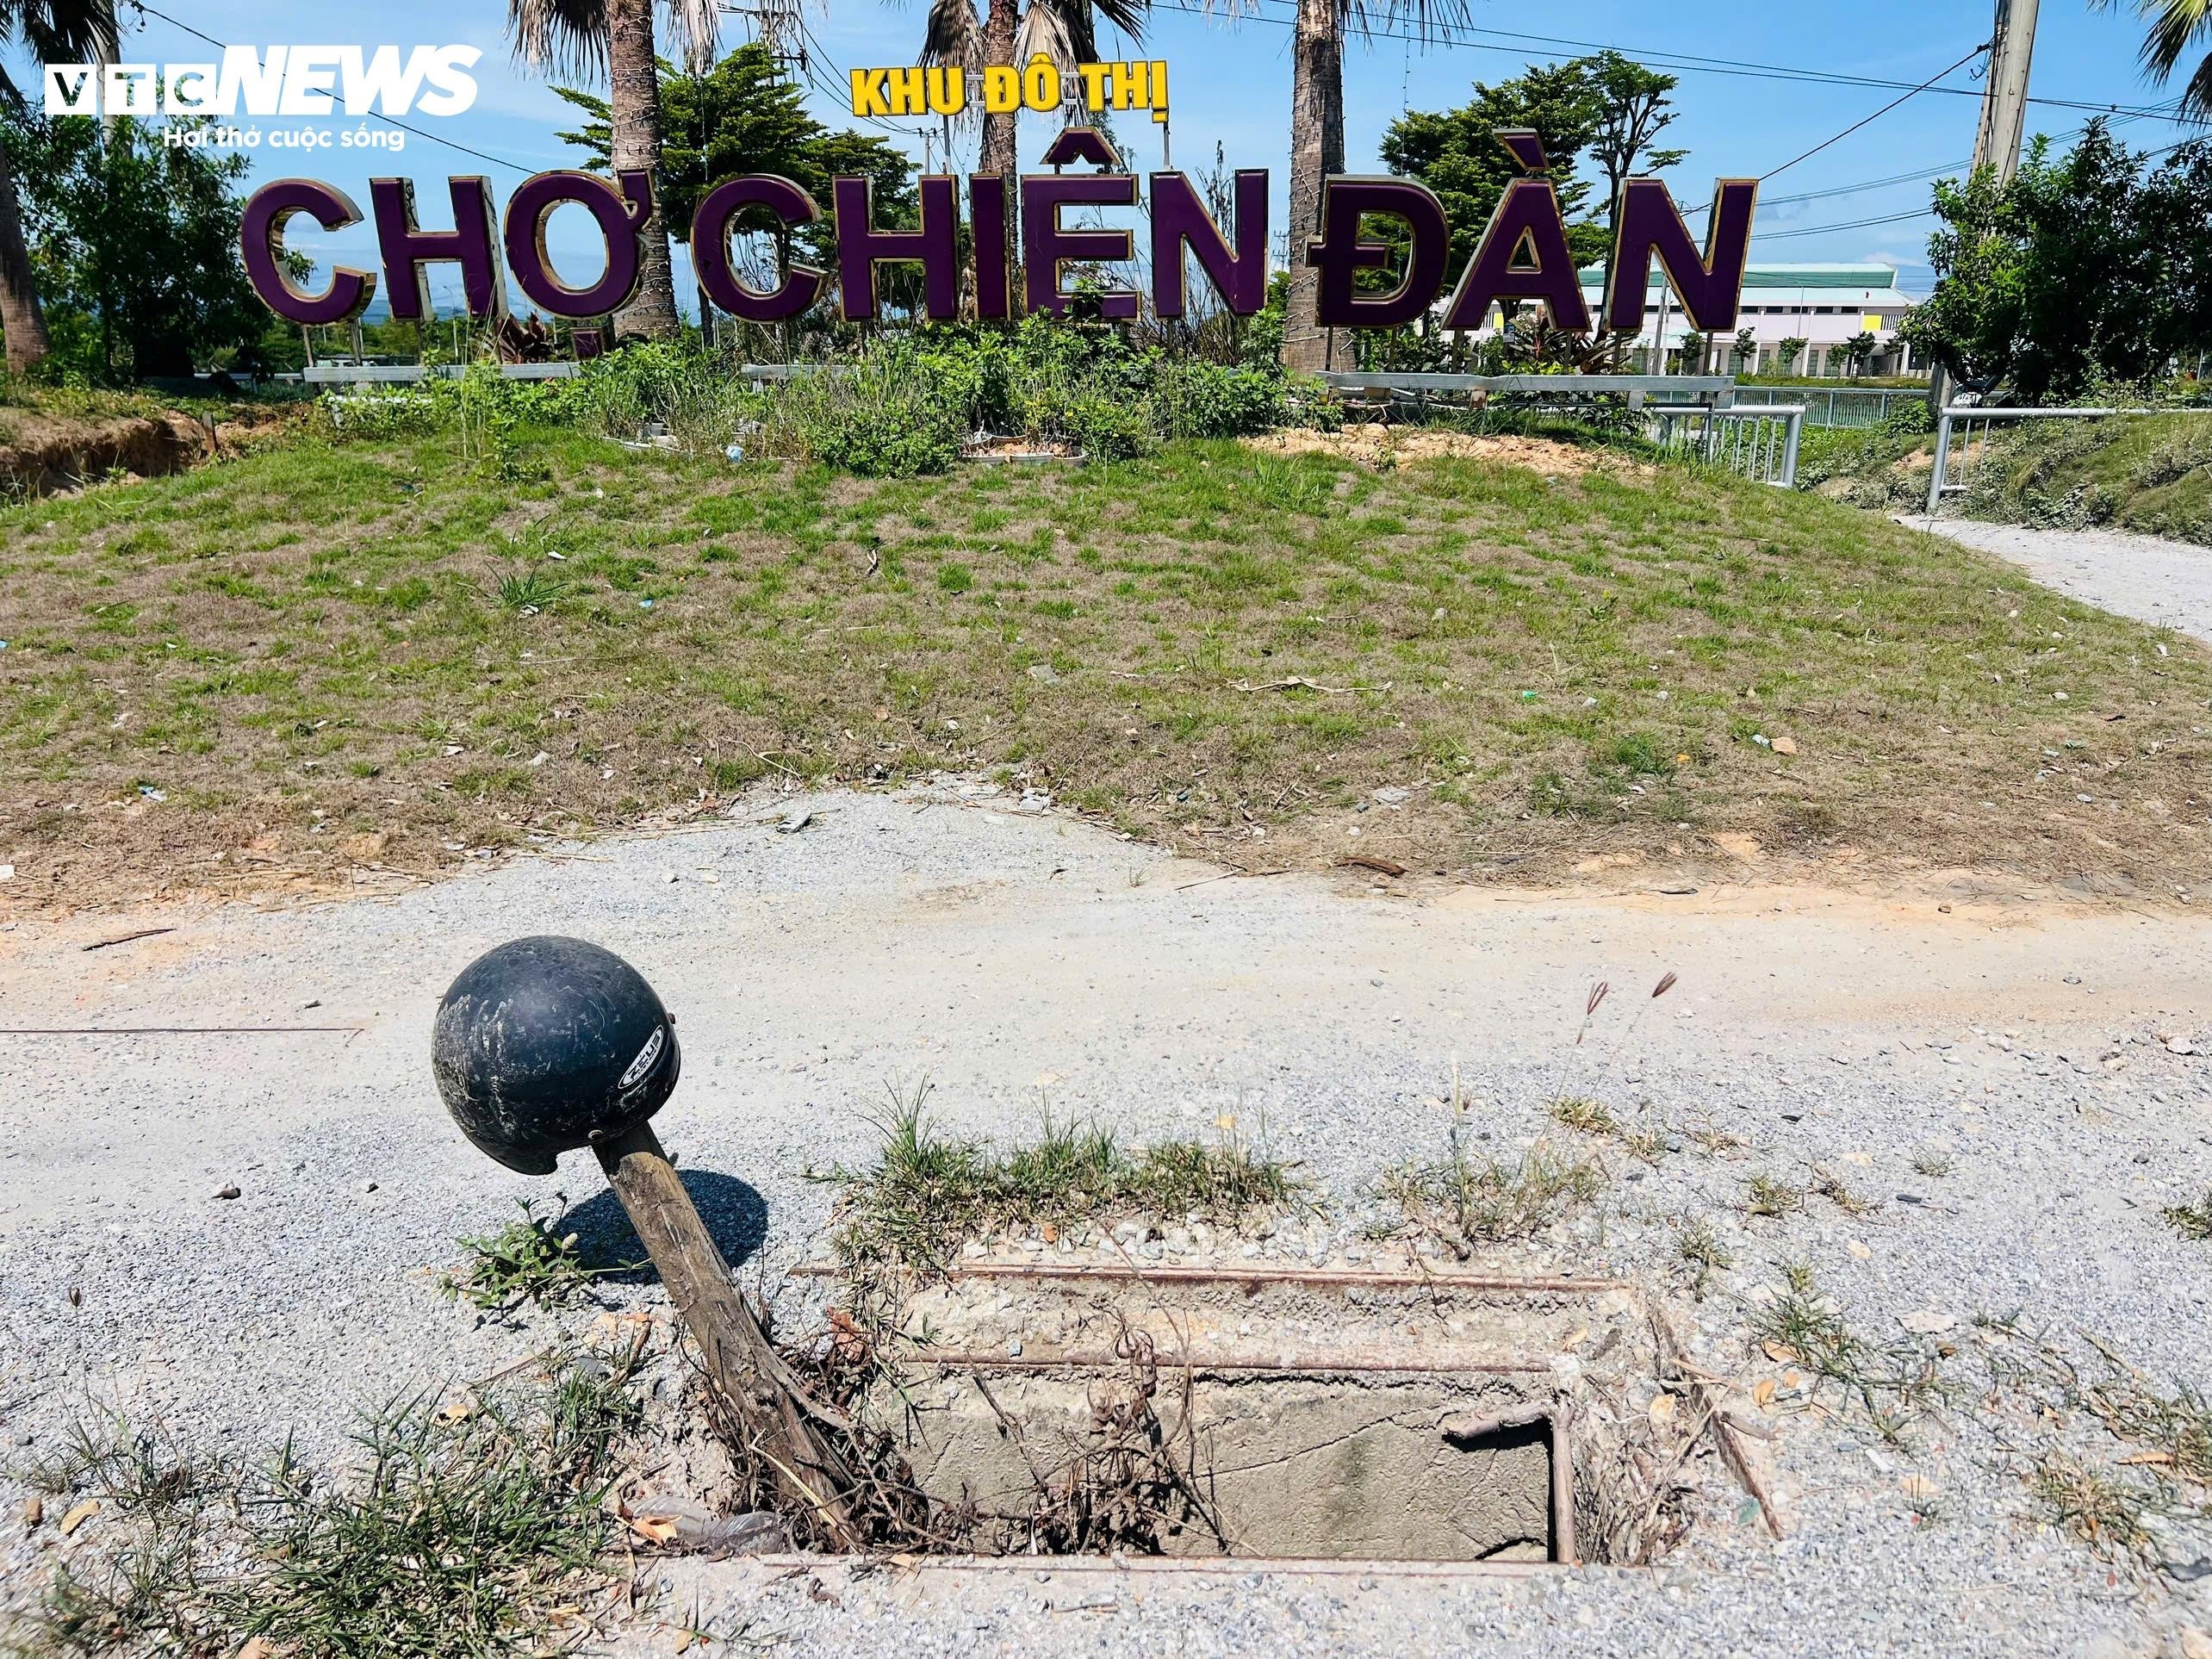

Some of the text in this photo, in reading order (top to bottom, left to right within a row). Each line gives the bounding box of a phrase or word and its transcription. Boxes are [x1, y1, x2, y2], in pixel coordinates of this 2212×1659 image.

[850, 53, 1169, 123] KHU ĐÔ THỊ
[239, 126, 1759, 360] CHỢ CHIÊN ĐÀN
[628, 1034, 661, 1079] ZEUS
